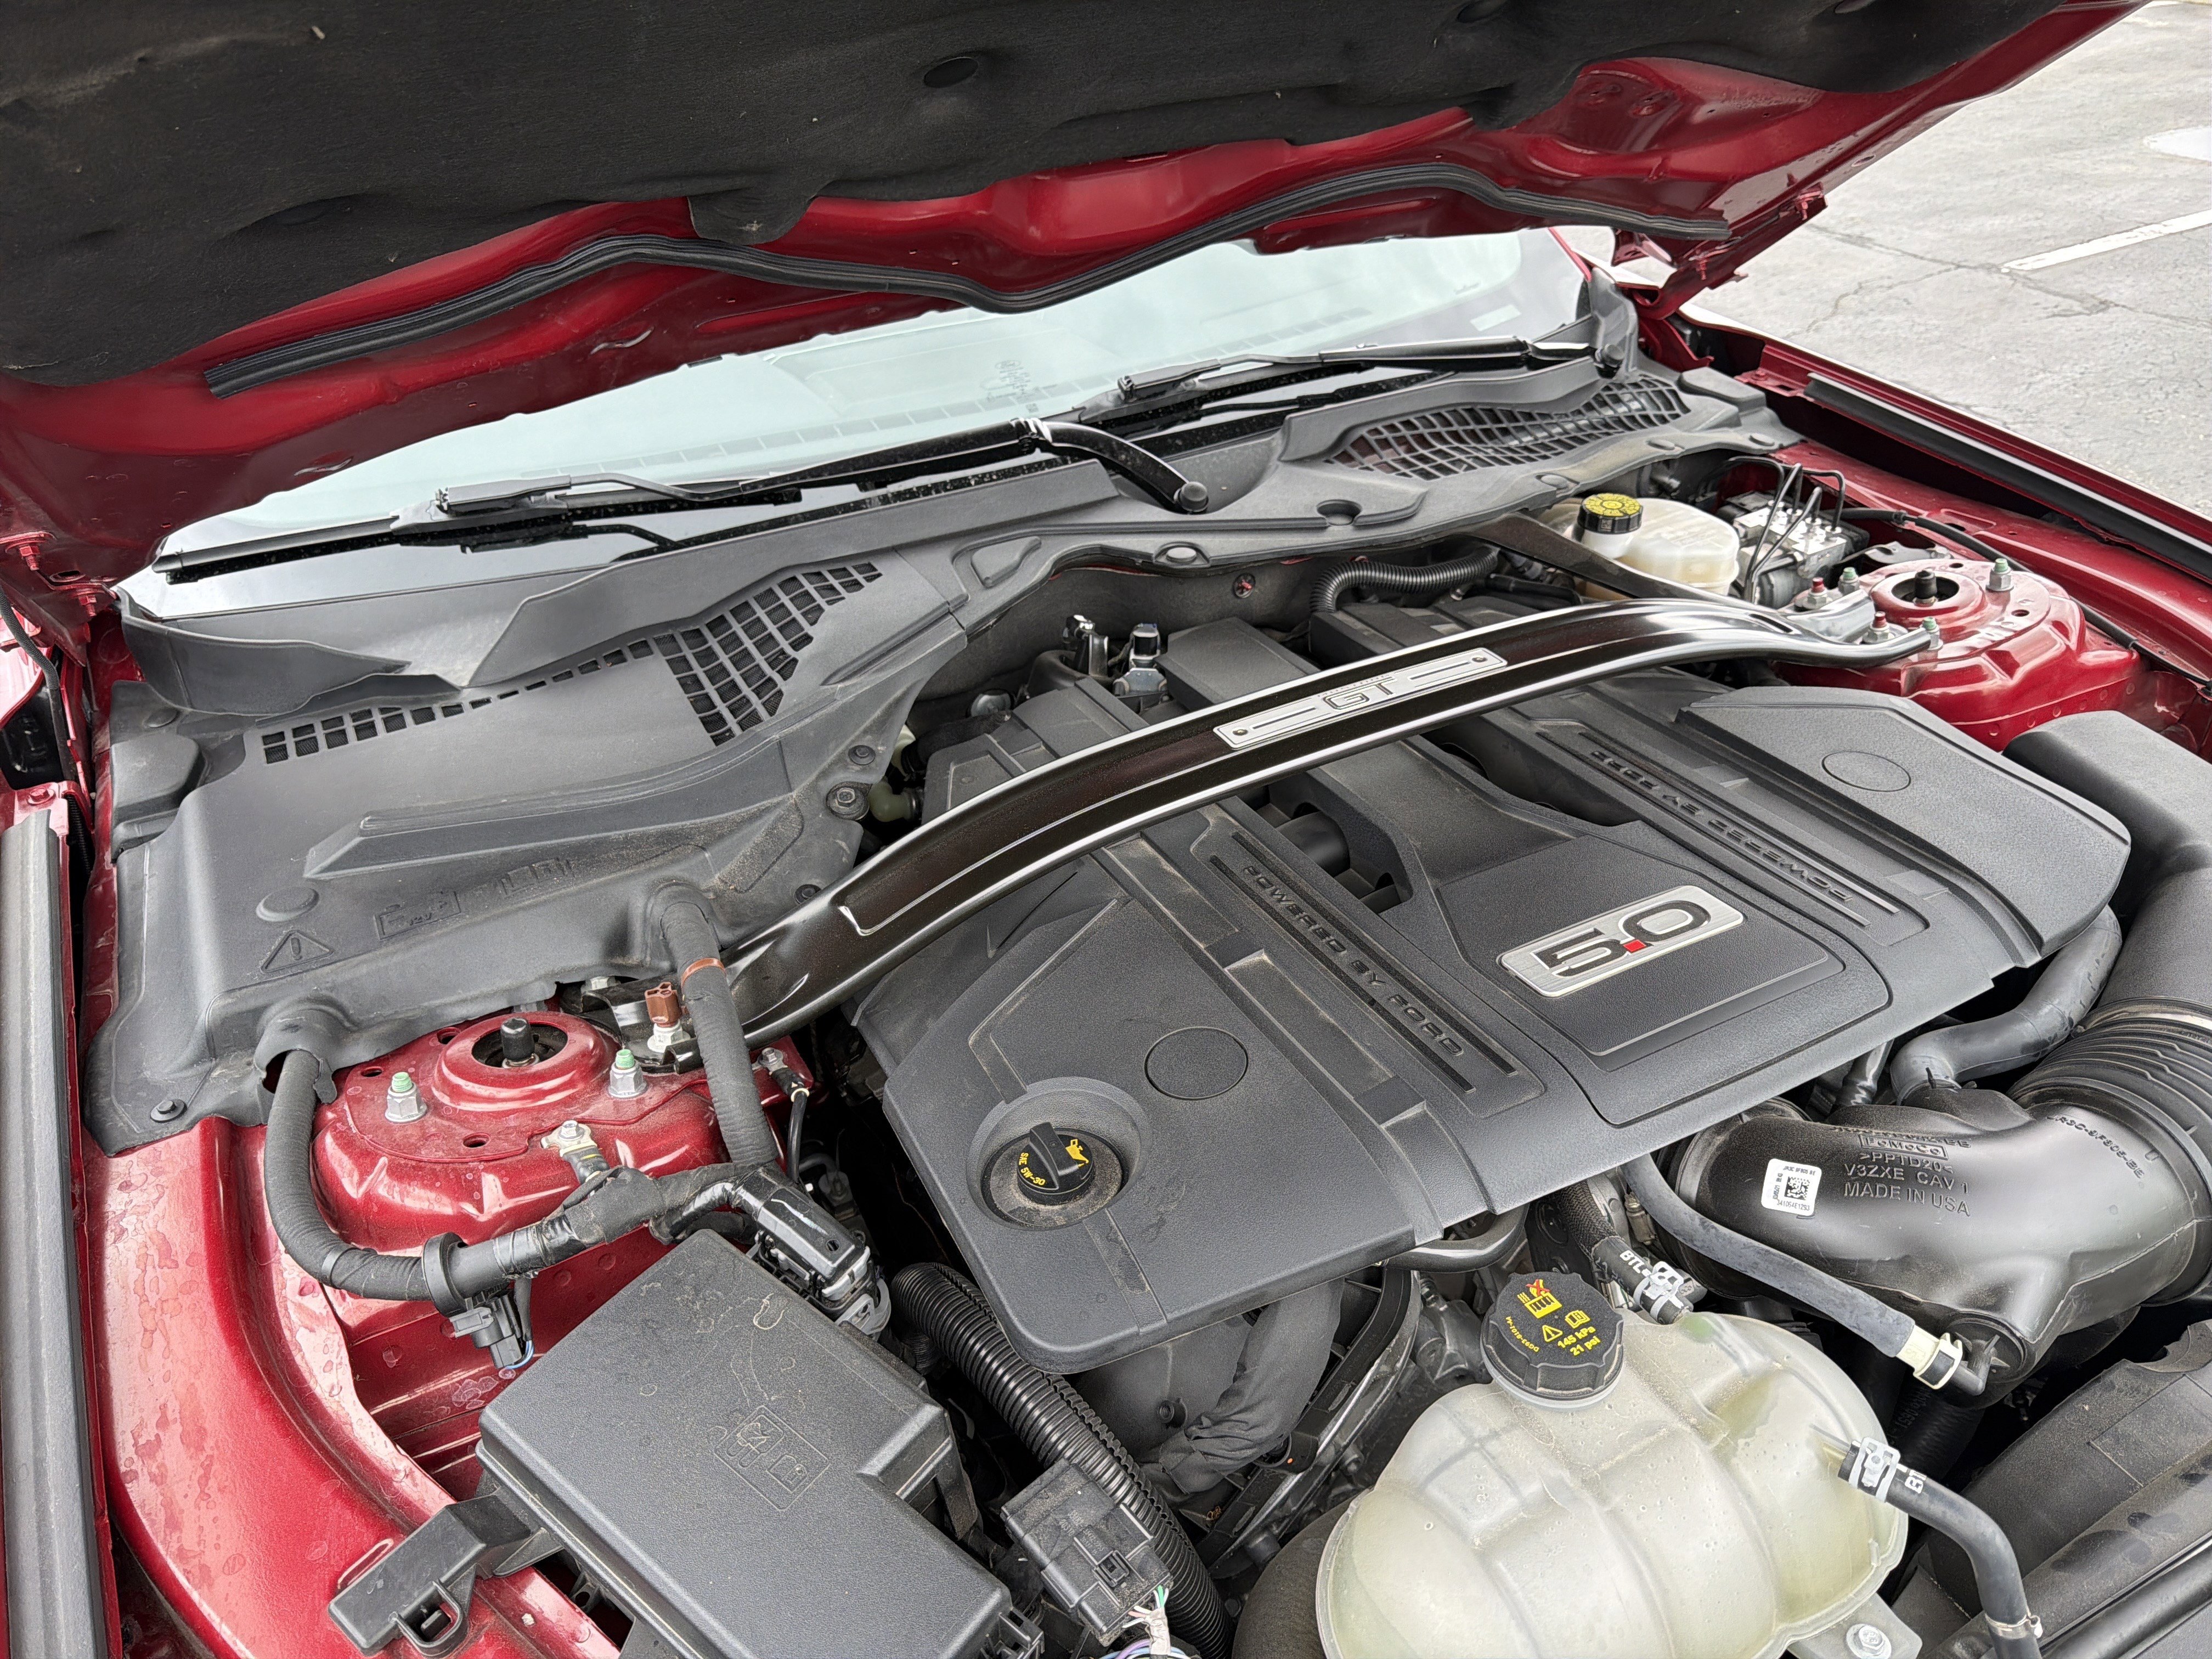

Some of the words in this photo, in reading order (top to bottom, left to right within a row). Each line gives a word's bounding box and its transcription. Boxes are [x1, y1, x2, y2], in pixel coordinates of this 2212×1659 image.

[1322, 676, 1398, 712] GT
[1590, 749, 1660, 791] FORD
[1662, 794, 1702, 816] BY
[1708, 818, 1853, 902] POWERED
[1530, 899, 1712, 978] 5.0
[1243, 866, 1348, 955] POWERED
[1350, 959, 1388, 986] BY
[1387, 993, 1464, 1057] FORD
[1019, 1152, 1029, 1165] SAE
[1865, 1136, 1942, 1156] FoMoCo
[1020, 1167, 1046, 1186] 5W-30
[1844, 1163, 1905, 1181] V3ZXE
[1917, 1171, 1955, 1190] CAV
[1961, 1181, 1968, 1194] 1
[1844, 1182, 1901, 1200] MADE
[1906, 1187, 1925, 1205] IN
[1932, 1193, 1971, 1217] USA
[1557, 1334, 1577, 1348] 145
[1574, 1326, 1596, 1340] kPa
[1570, 1345, 1584, 1357] 21
[1584, 1335, 1601, 1350] psi
